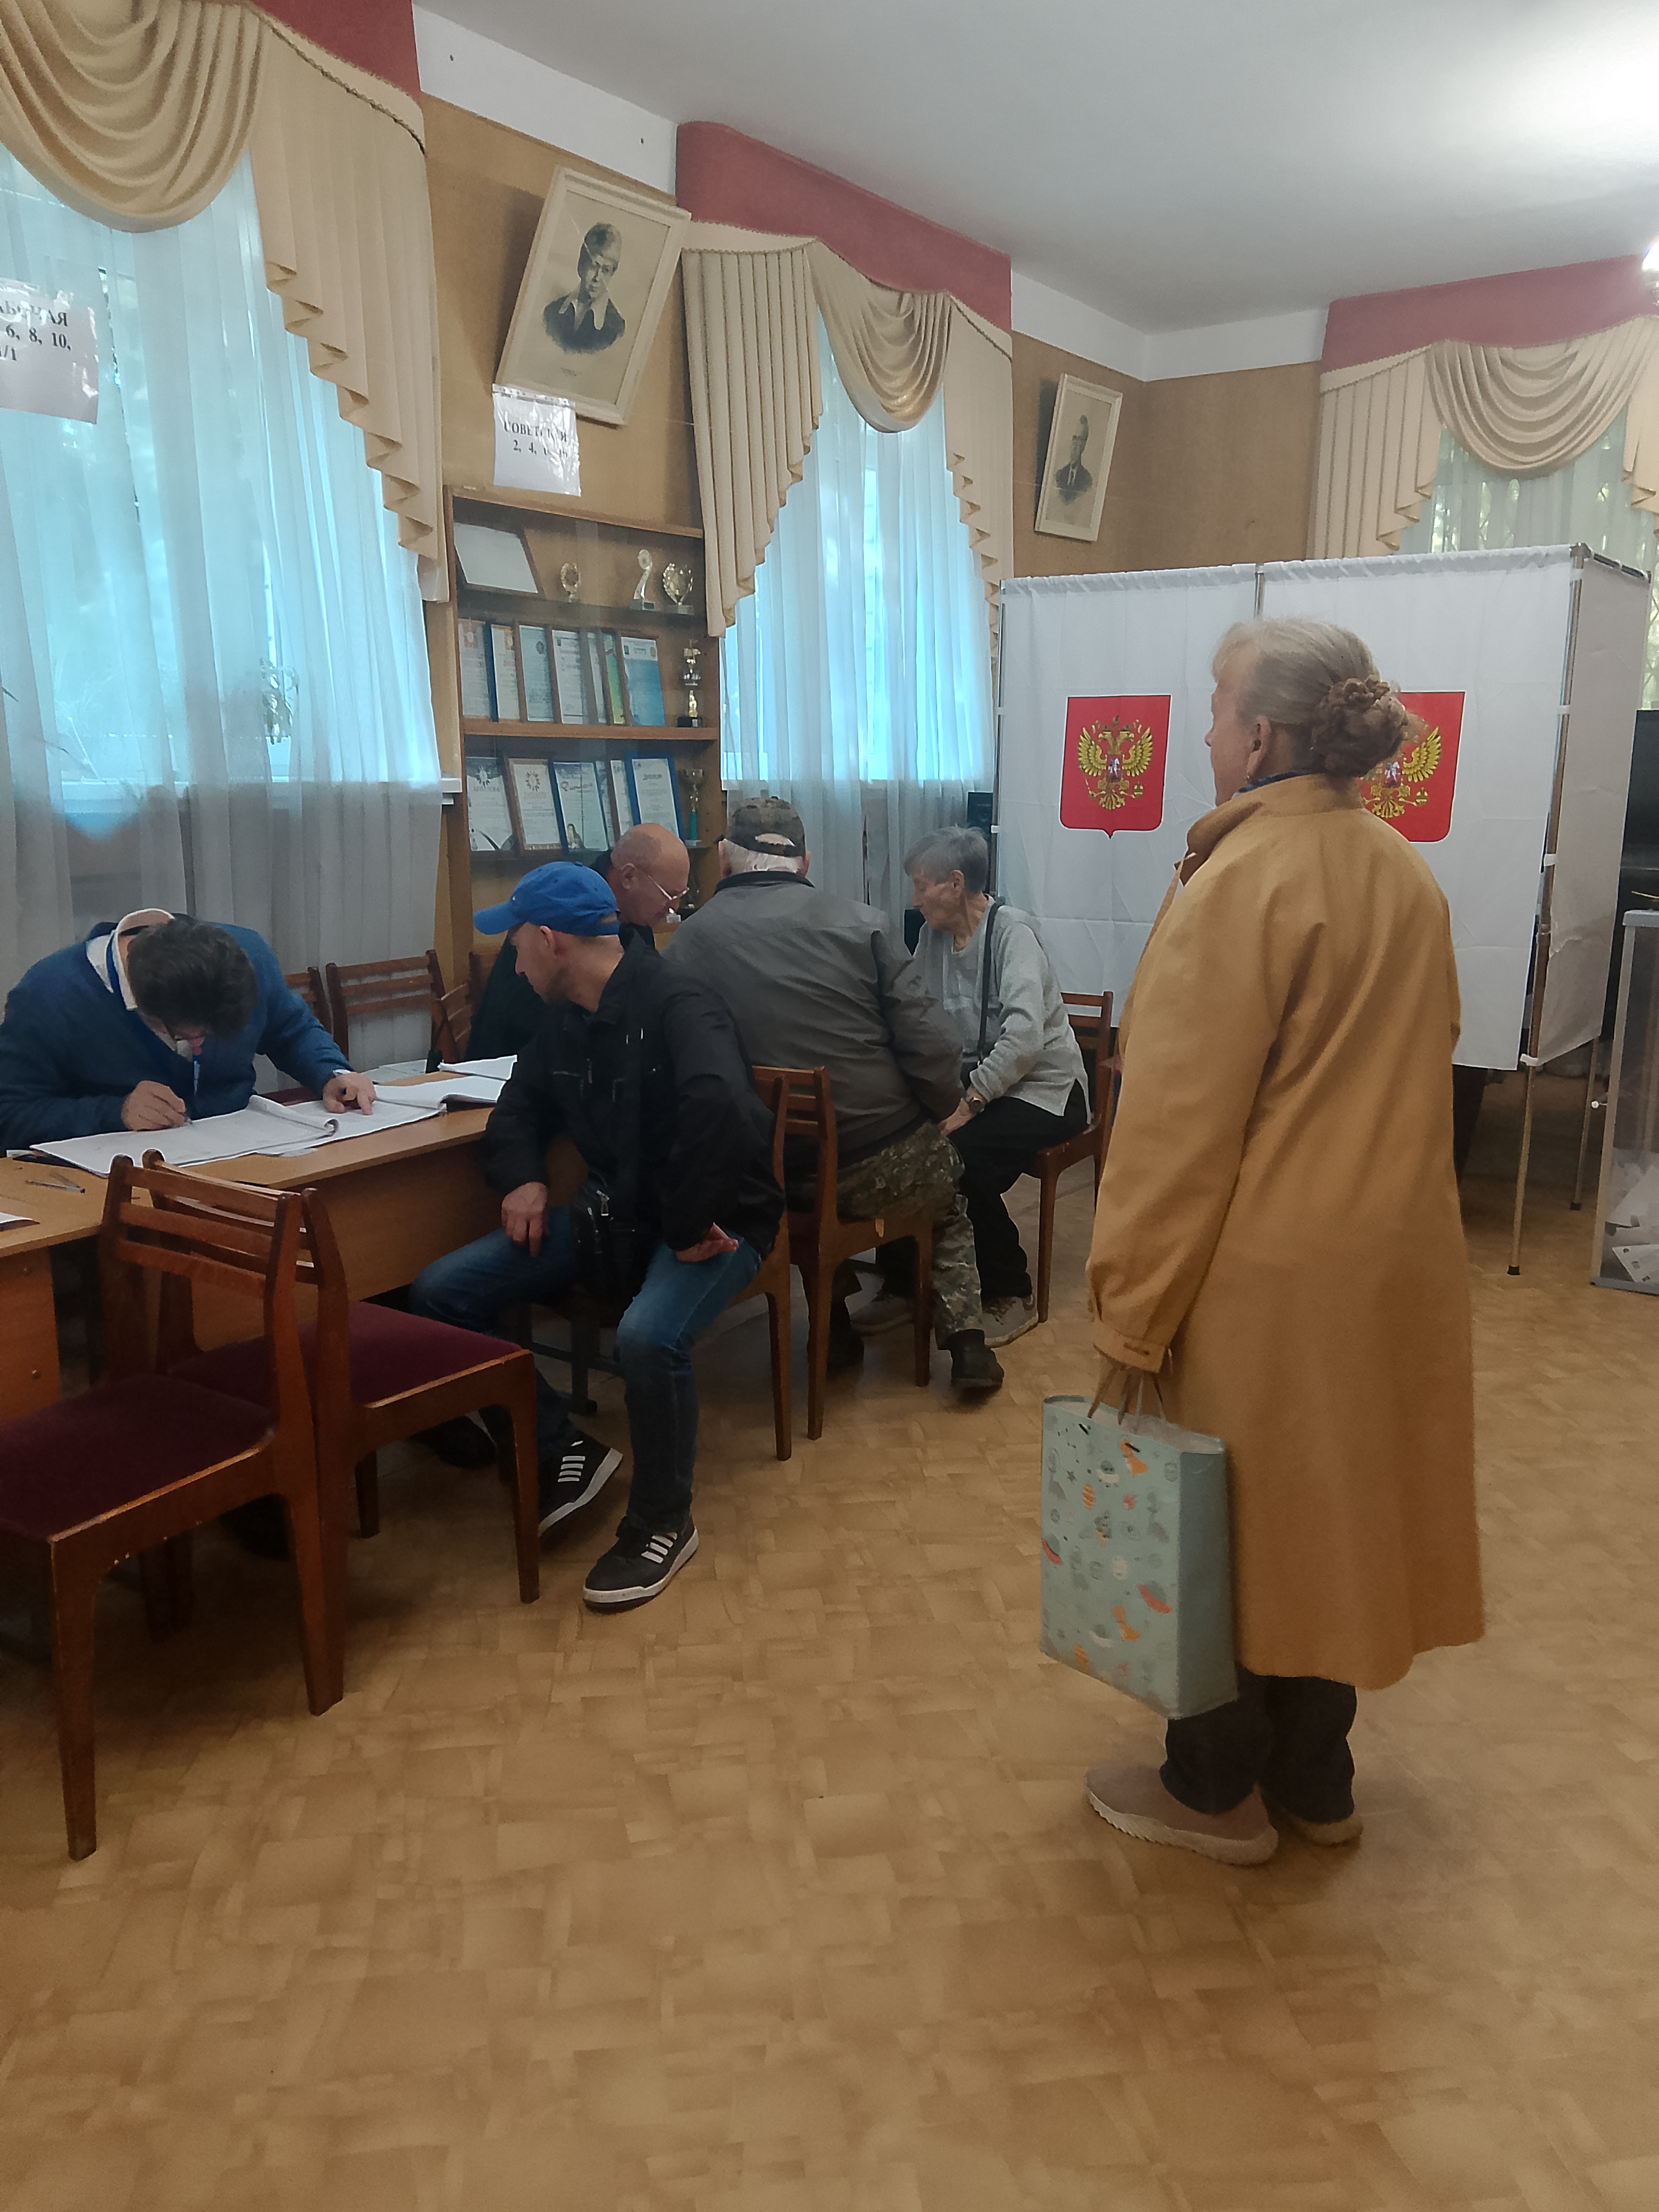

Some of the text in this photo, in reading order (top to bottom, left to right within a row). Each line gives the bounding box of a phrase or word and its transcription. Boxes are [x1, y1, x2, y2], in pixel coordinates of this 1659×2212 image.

[5, 323, 71, 351] 6, 8, 10,
[0, 345, 16, 361] /1
[513, 439, 522, 453] 2,
[529, 442, 537, 455] 4,
